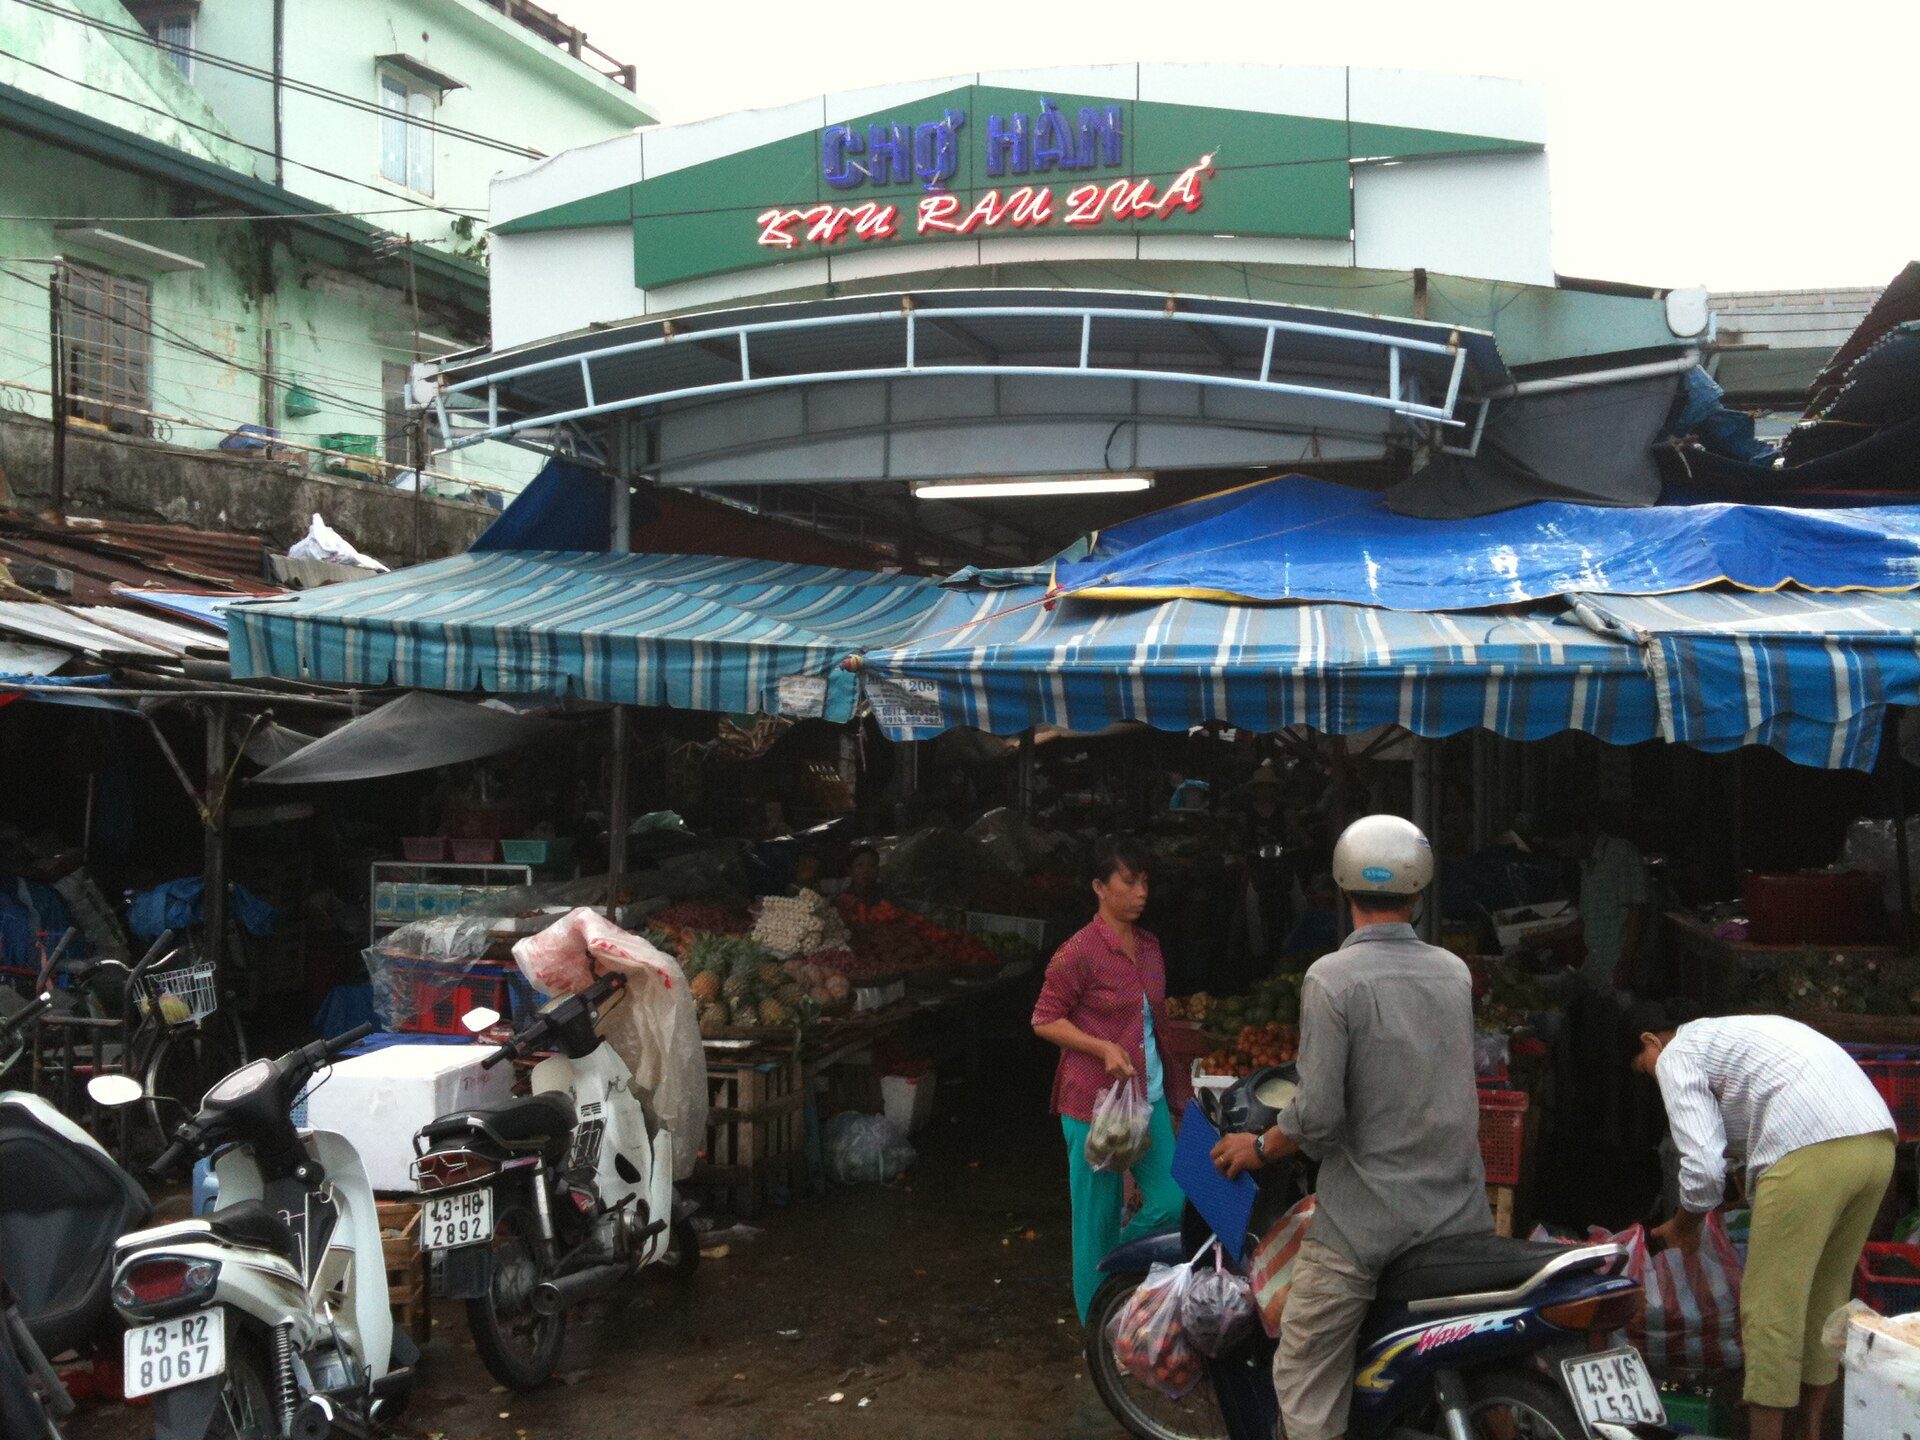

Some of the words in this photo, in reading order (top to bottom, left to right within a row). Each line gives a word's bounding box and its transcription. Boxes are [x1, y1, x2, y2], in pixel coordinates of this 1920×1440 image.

[822, 109, 965, 194] CHỢ
[986, 96, 1122, 176] HÀN
[757, 202, 897, 249] KHU
[917, 190, 1053, 234] RAU
[433, 1217, 481, 1246] 2892
[140, 1315, 209, 1357] 43-R2
[1417, 1322, 1477, 1355] Wave
[140, 1345, 209, 1388] 8067
